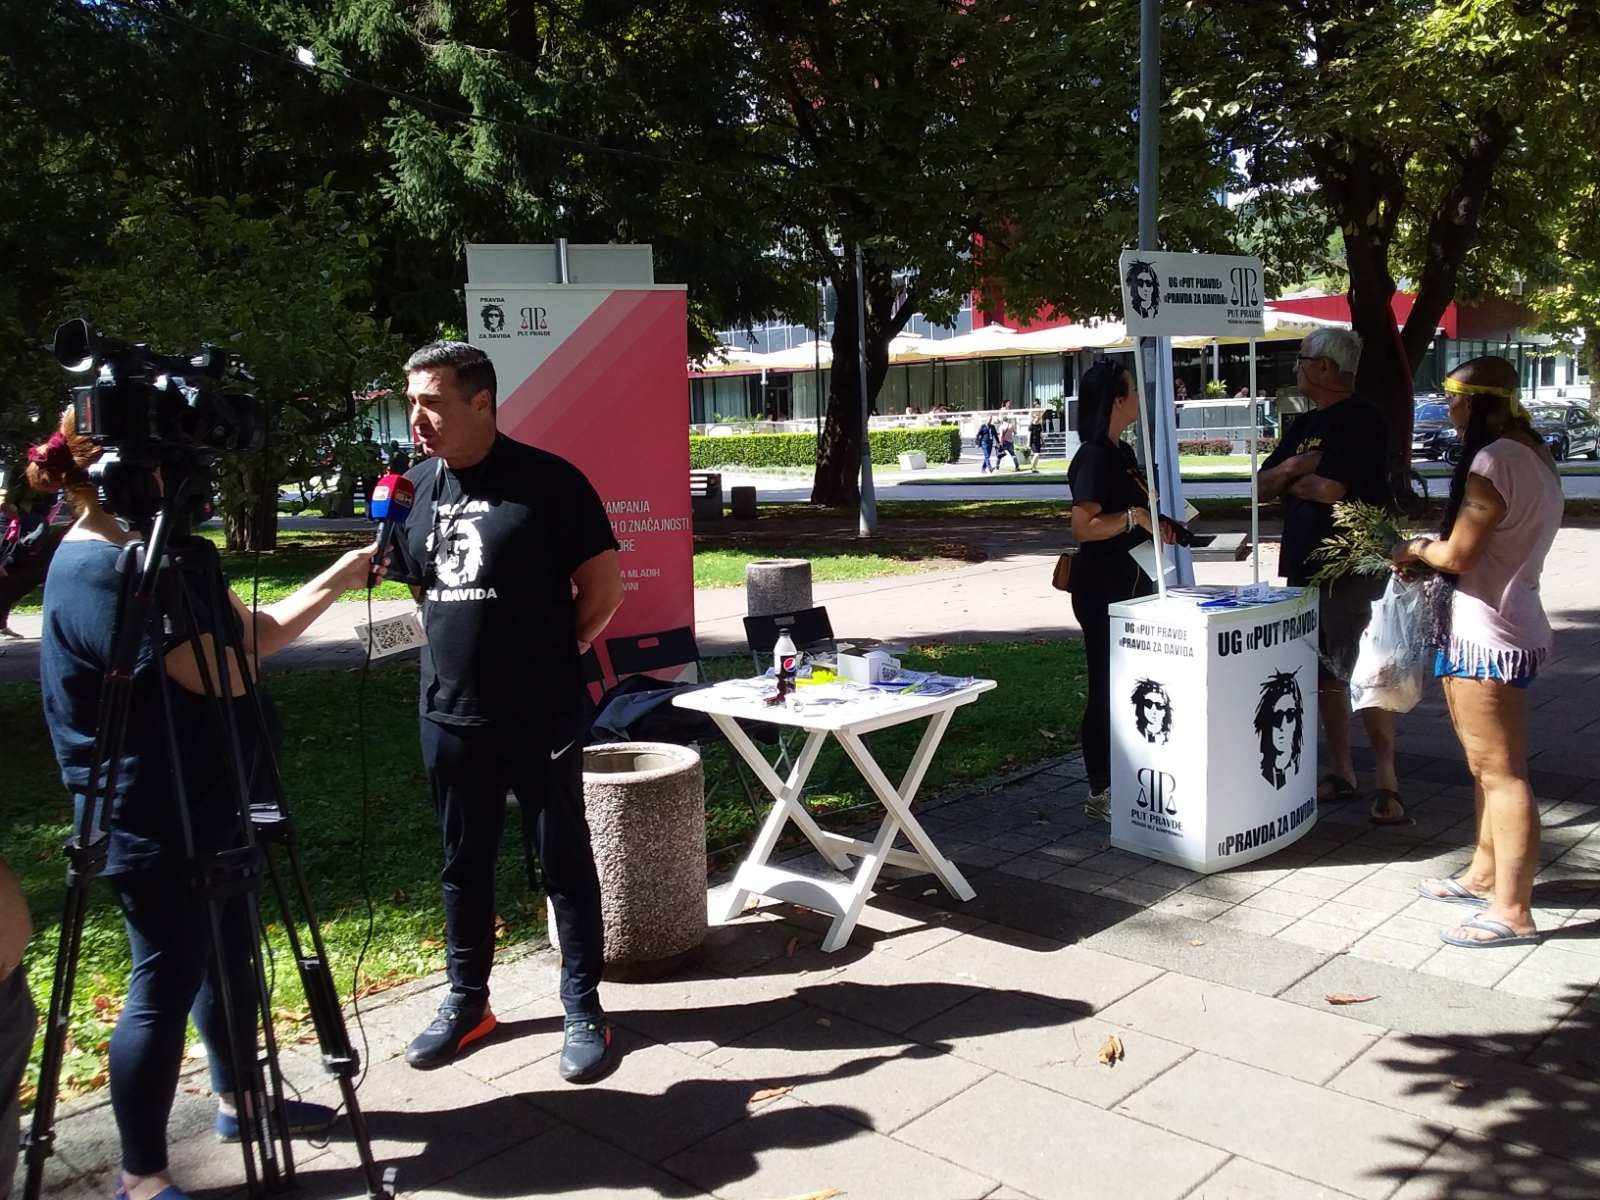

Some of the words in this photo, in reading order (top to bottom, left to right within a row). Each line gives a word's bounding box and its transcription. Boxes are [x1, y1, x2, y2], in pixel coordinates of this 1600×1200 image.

[1193, 293, 1202, 304] ZA
[1227, 309, 1239, 318] PUT
[603, 501, 650, 514] AMPANJA
[628, 517, 689, 533] ZNAČAJNOSTI
[440, 587, 498, 602] DAVIDA
[1124, 622, 1136, 634] UG
[1152, 641, 1162, 653] ZA
[1217, 629, 1243, 657] UG
[1131, 808, 1149, 821] PUT
[1149, 813, 1184, 832] PRAVDE
[1277, 814, 1289, 838] ZA
